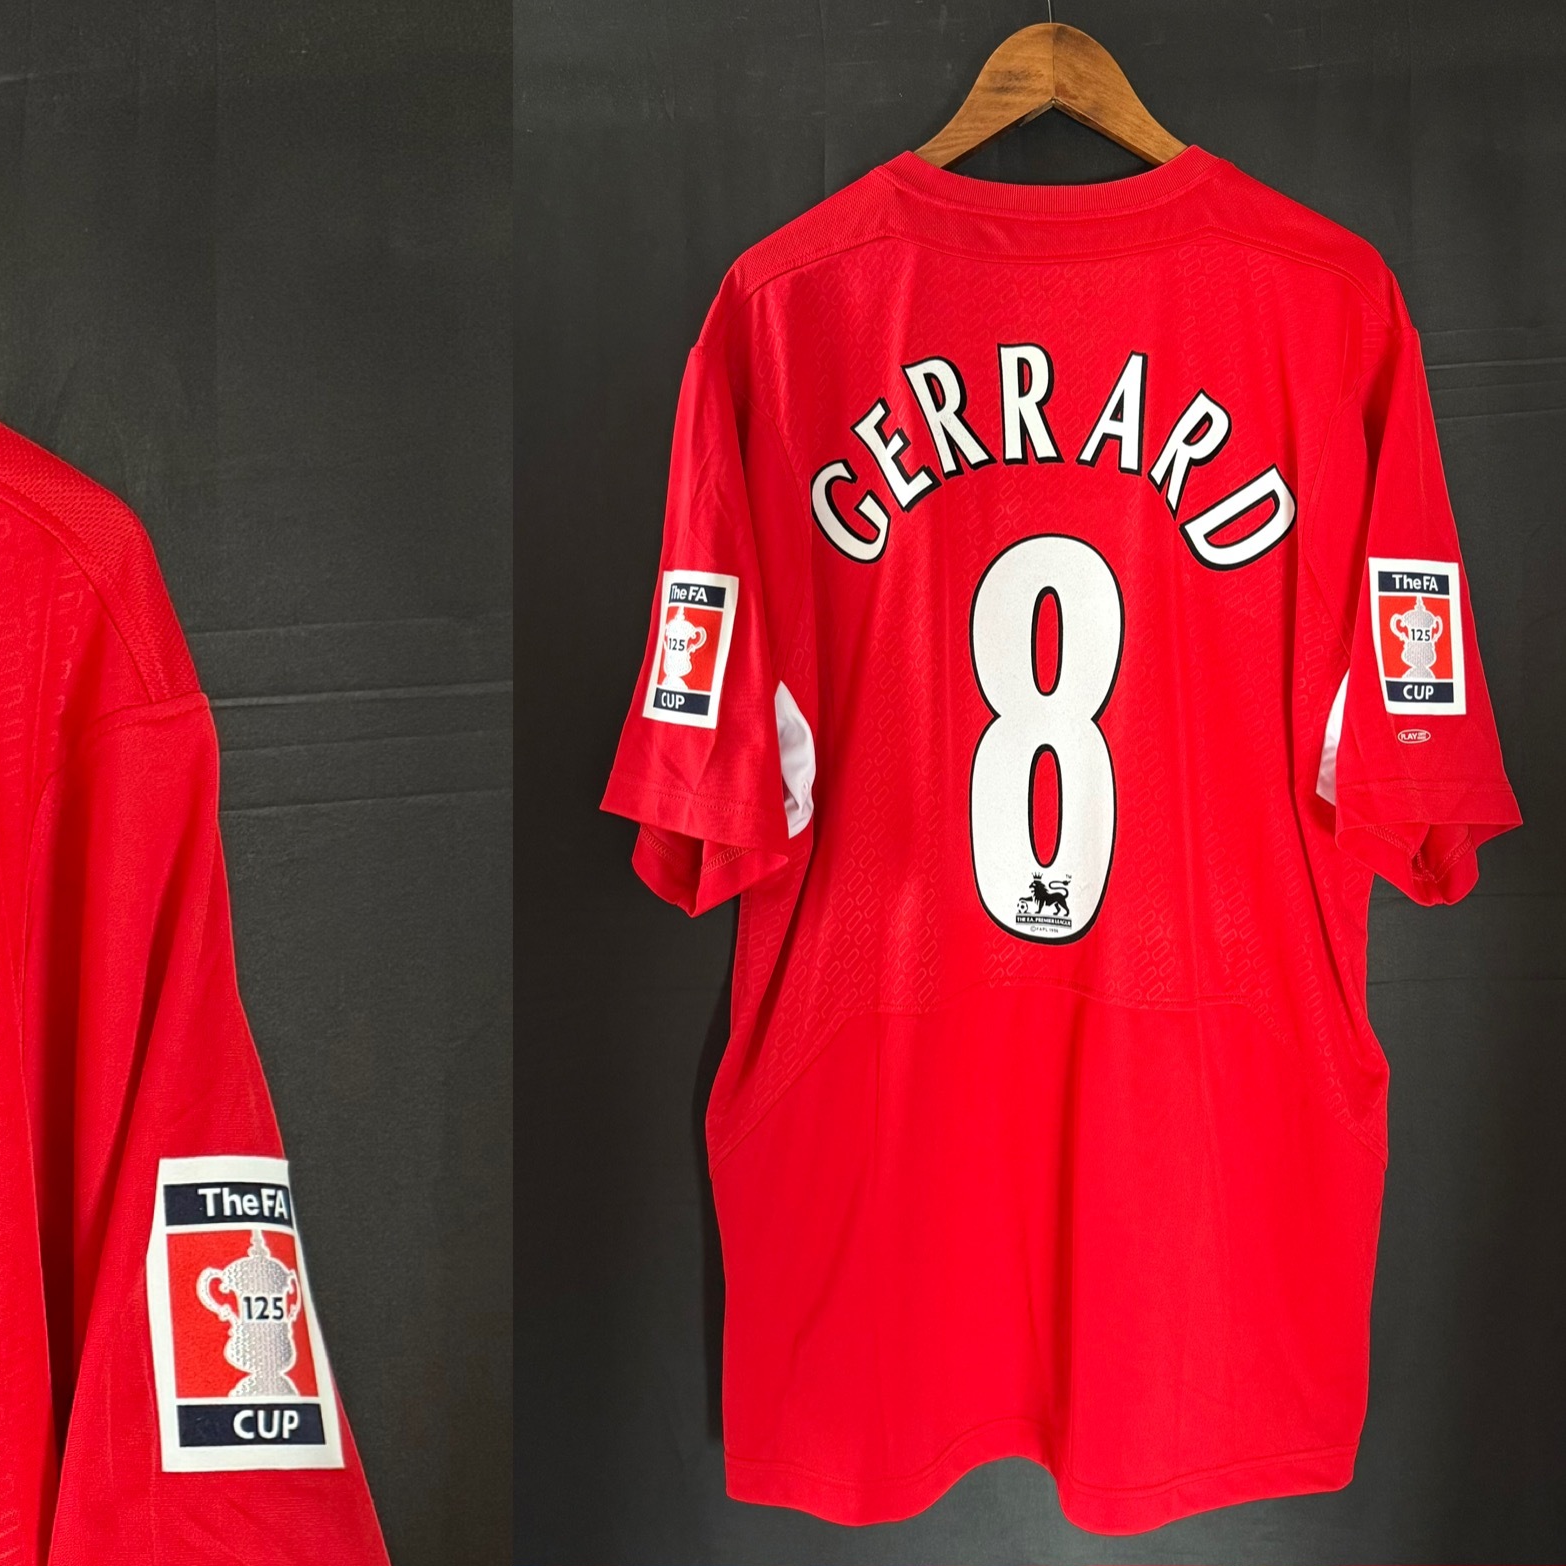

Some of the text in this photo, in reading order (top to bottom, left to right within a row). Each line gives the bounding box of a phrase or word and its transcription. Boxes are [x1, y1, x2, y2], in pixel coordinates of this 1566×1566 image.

[810, 343, 1297, 571] GERRARD
[1392, 574, 1438, 591] The FA
[671, 585, 708, 603] The FA
[1411, 628, 1431, 642] 125
[668, 638, 686, 651] 125
[661, 692, 685, 709] CUP
[1403, 684, 1434, 700] CUP
[969, 533, 1125, 945] 8
[198, 1187, 289, 1219] The FA
[243, 1297, 284, 1320] 125
[233, 1409, 299, 1439] CUP
